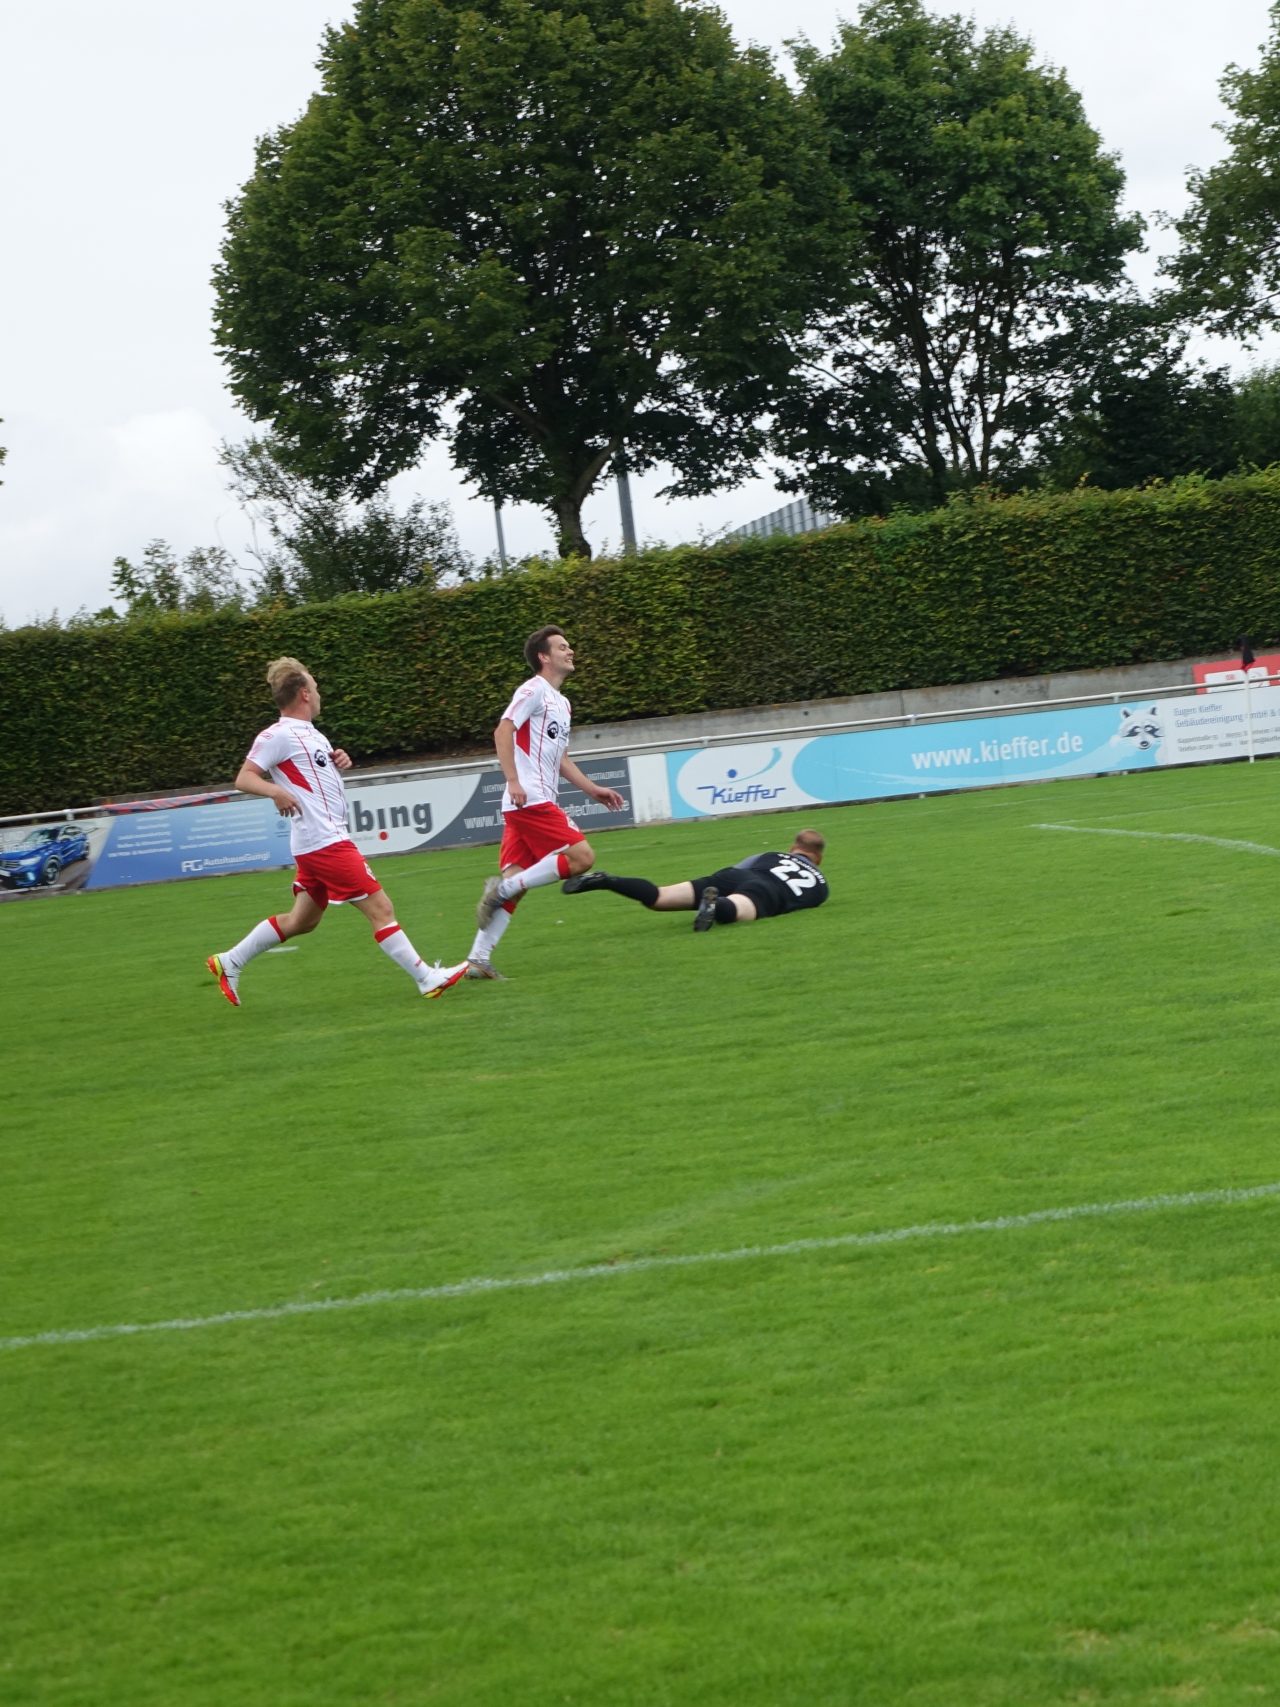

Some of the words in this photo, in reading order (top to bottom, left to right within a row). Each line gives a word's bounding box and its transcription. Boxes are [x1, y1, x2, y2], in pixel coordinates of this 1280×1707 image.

[911, 731, 1083, 770] www.kieffer.de
[697, 784, 786, 805] Kieffer
[769, 859, 817, 897] 22
